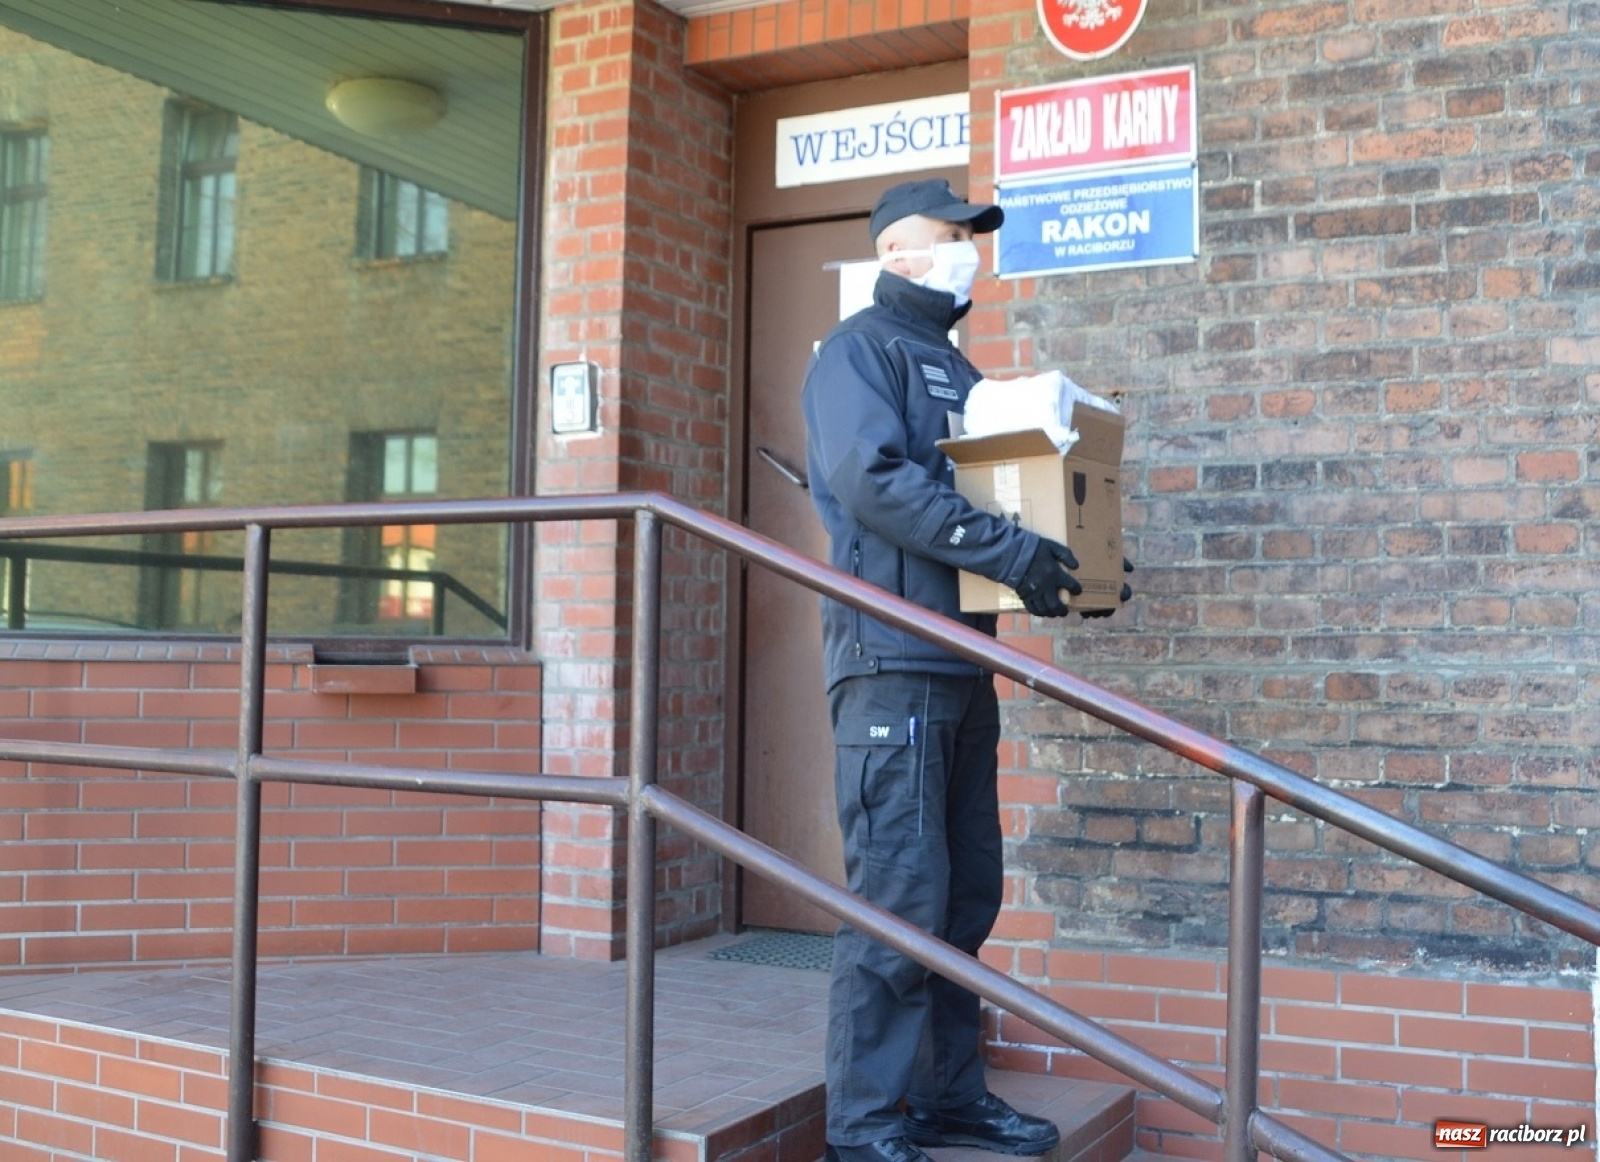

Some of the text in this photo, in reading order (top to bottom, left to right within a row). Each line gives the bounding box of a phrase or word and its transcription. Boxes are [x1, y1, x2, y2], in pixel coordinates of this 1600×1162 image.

[1009, 84, 1179, 162] ZAKŁAD KARNY
[1000, 176, 1193, 209] PAŃSTWOWE PRZEDSIĘBIORSTWO
[1059, 197, 1128, 216] ODZIEŻOWE
[1041, 209, 1151, 244] RAKON
[1054, 238, 1136, 258] W RACIBORZU
[949, 524, 966, 546] SW
[869, 725, 891, 739] SW
